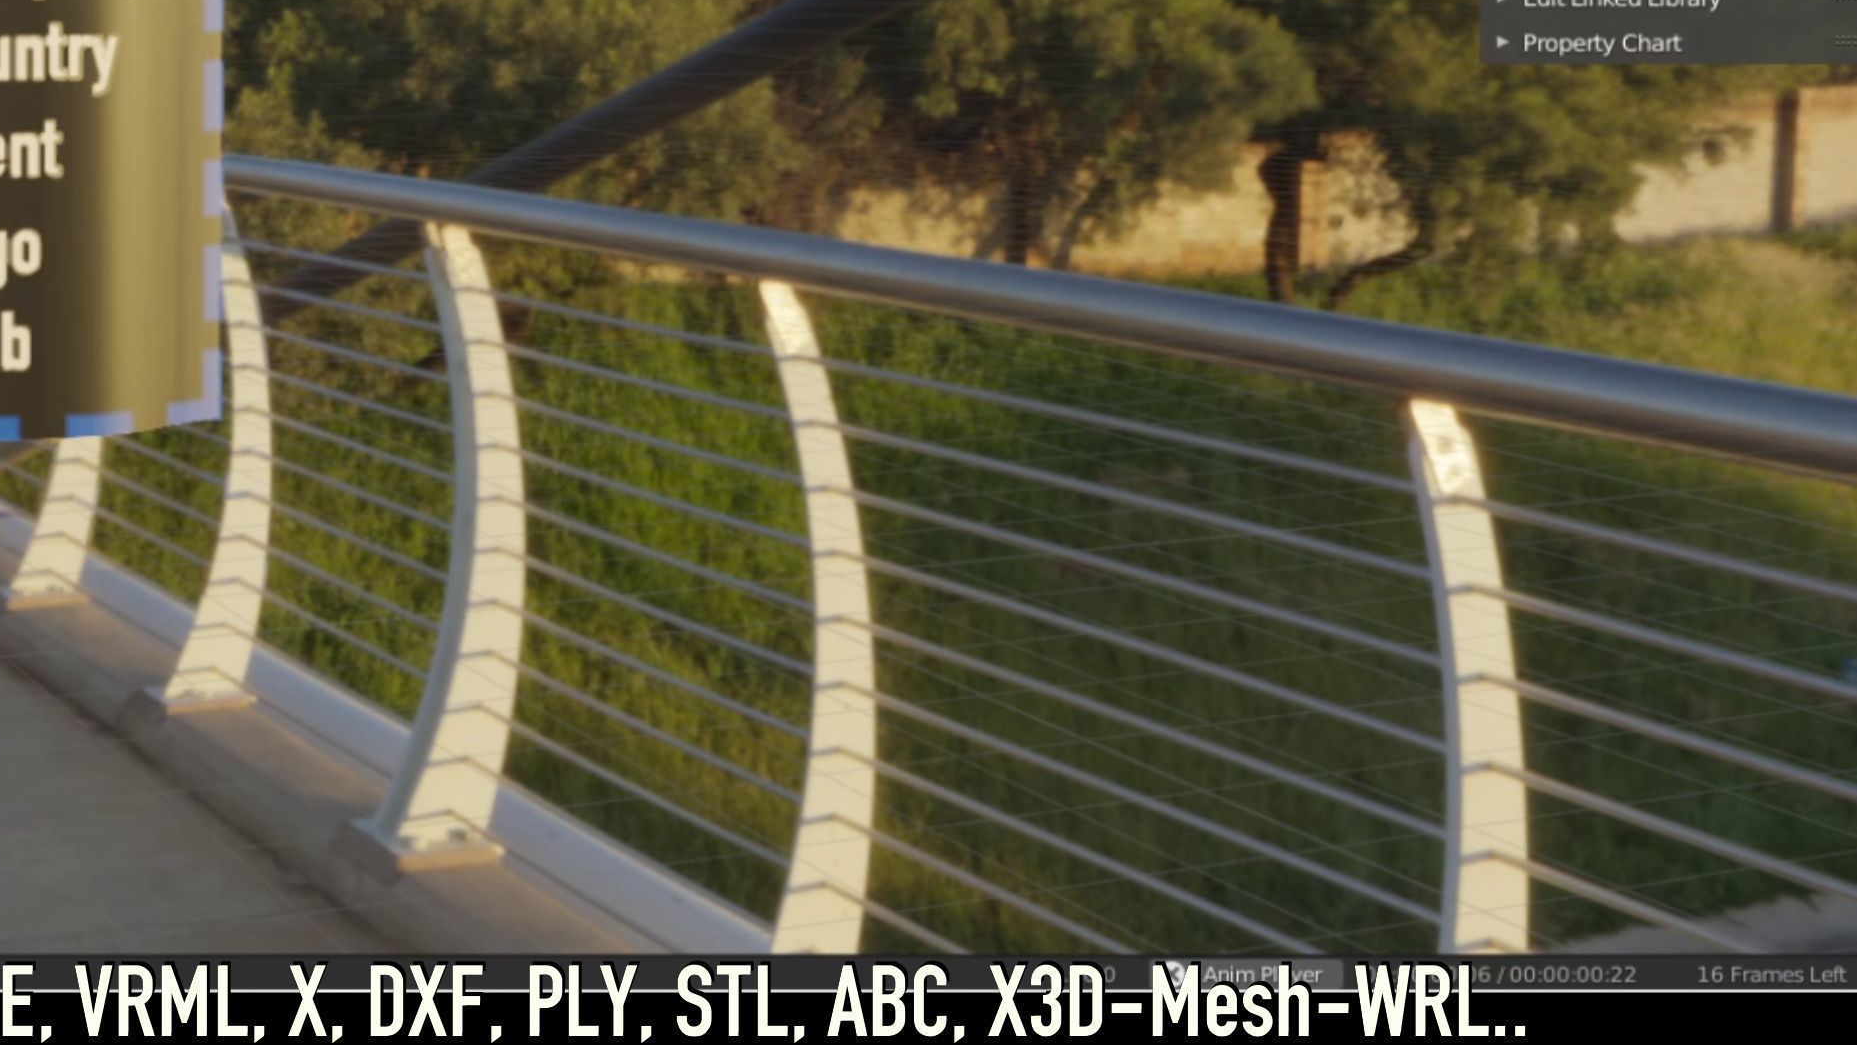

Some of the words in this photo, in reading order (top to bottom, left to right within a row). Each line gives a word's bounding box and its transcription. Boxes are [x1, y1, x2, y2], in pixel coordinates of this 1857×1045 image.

[1522, 33, 1616, 58] Property
[1622, 33, 1682, 53] Chart
[1202, 965, 1255, 983] Anim
[1509, 966, 1637, 983] 00:00:00:22
[1697, 966, 1724, 983] 16
[1730, 966, 1804, 983] Frames
[1810, 966, 1848, 983] Left
